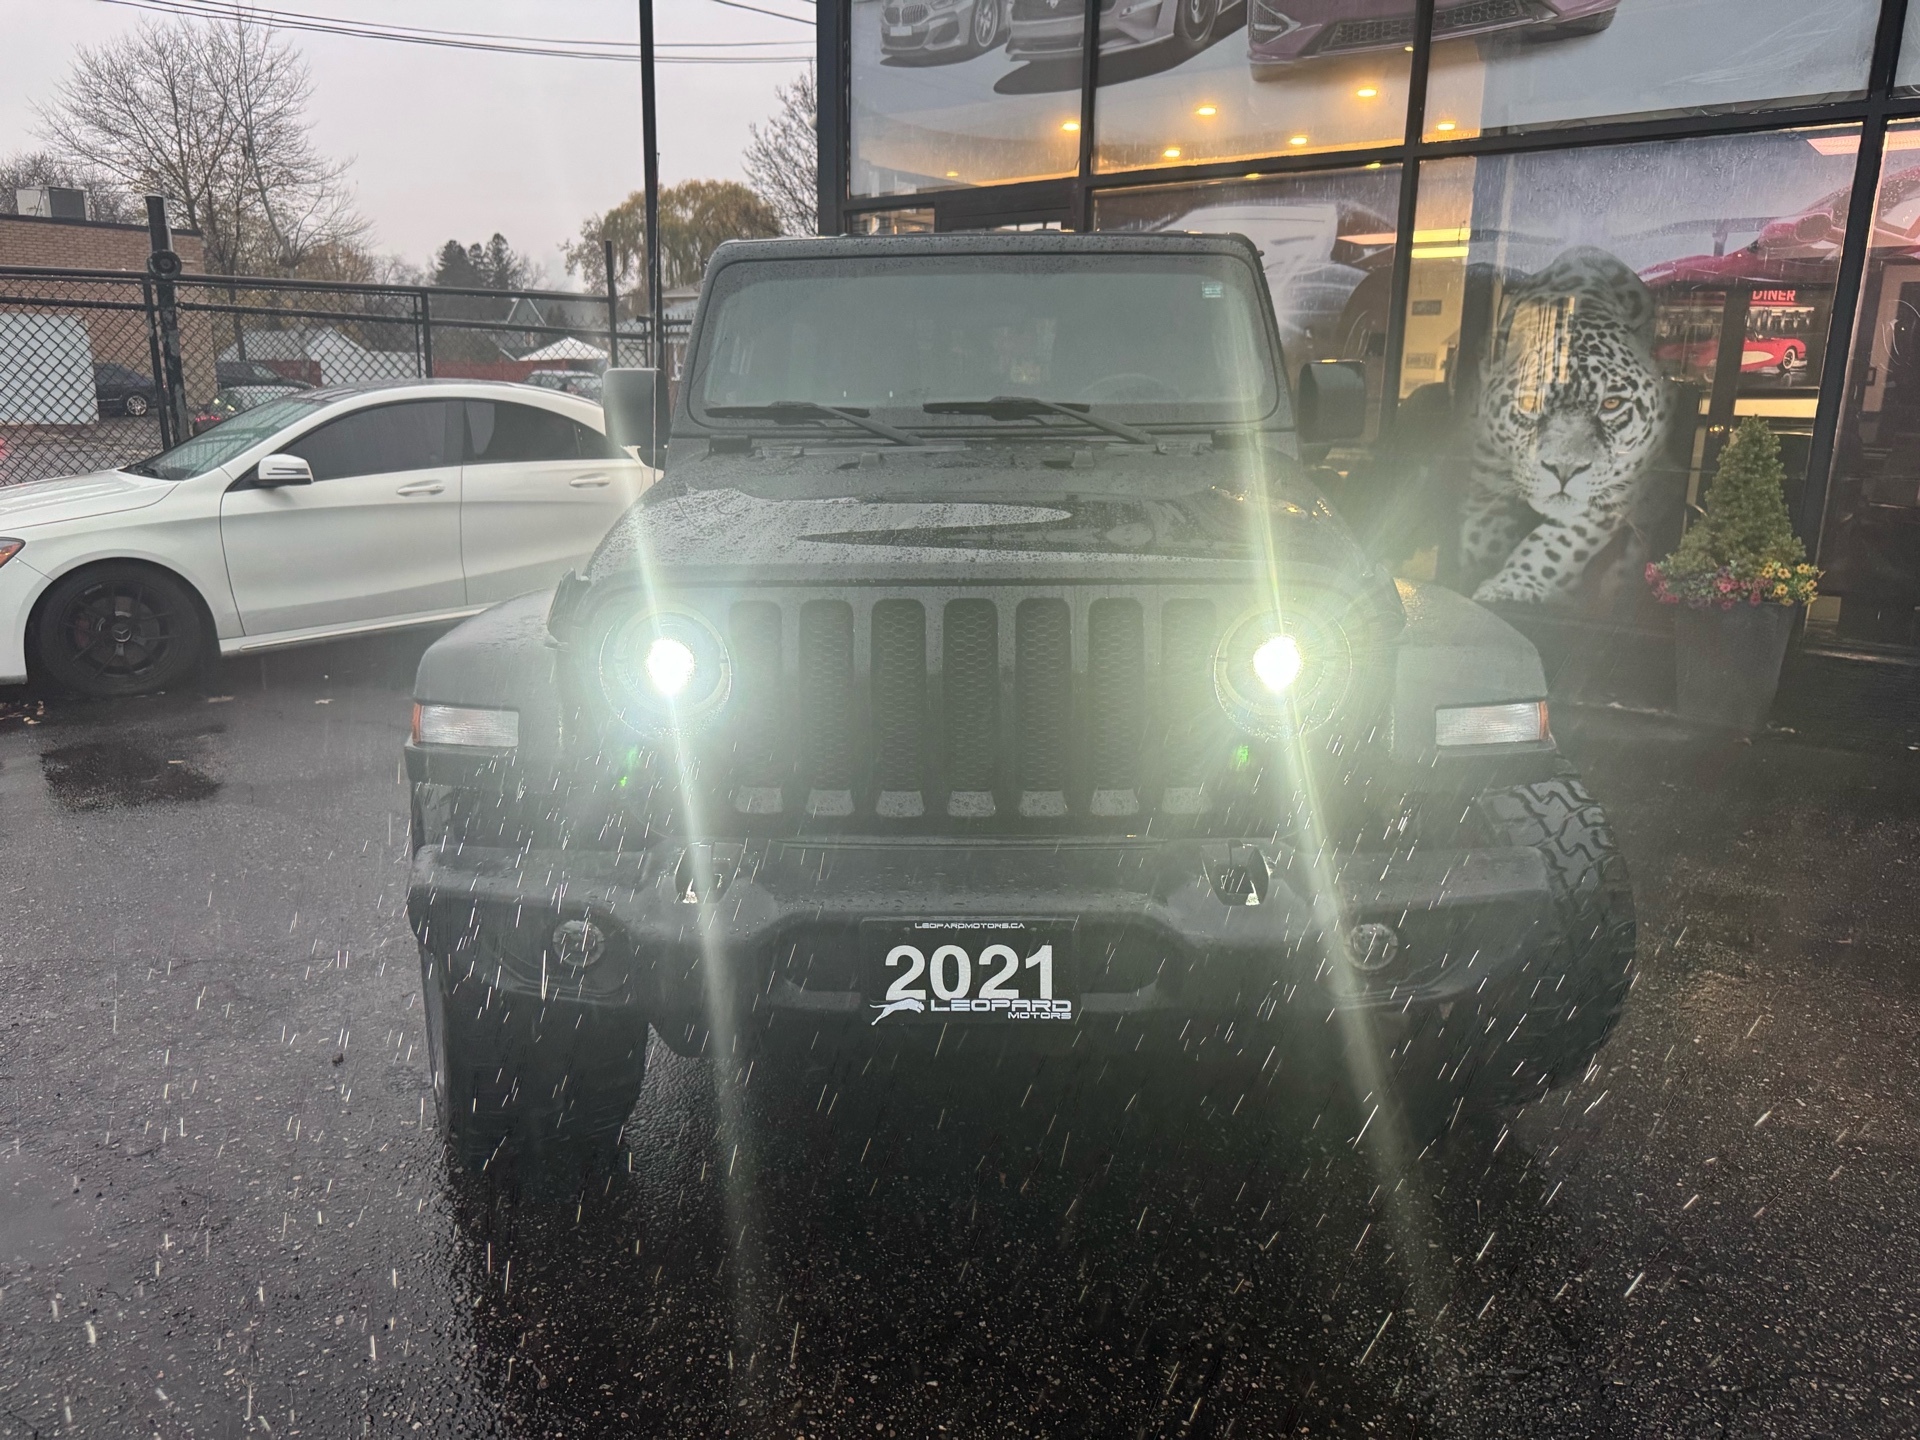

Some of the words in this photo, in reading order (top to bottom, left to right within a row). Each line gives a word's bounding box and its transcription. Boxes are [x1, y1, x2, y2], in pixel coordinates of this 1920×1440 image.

[1752, 290, 1796, 301] DINER
[885, 944, 1053, 1000] 2021
[930, 999, 1072, 1012] LEOPARD
[1007, 1011, 1072, 1020] MOTORS
